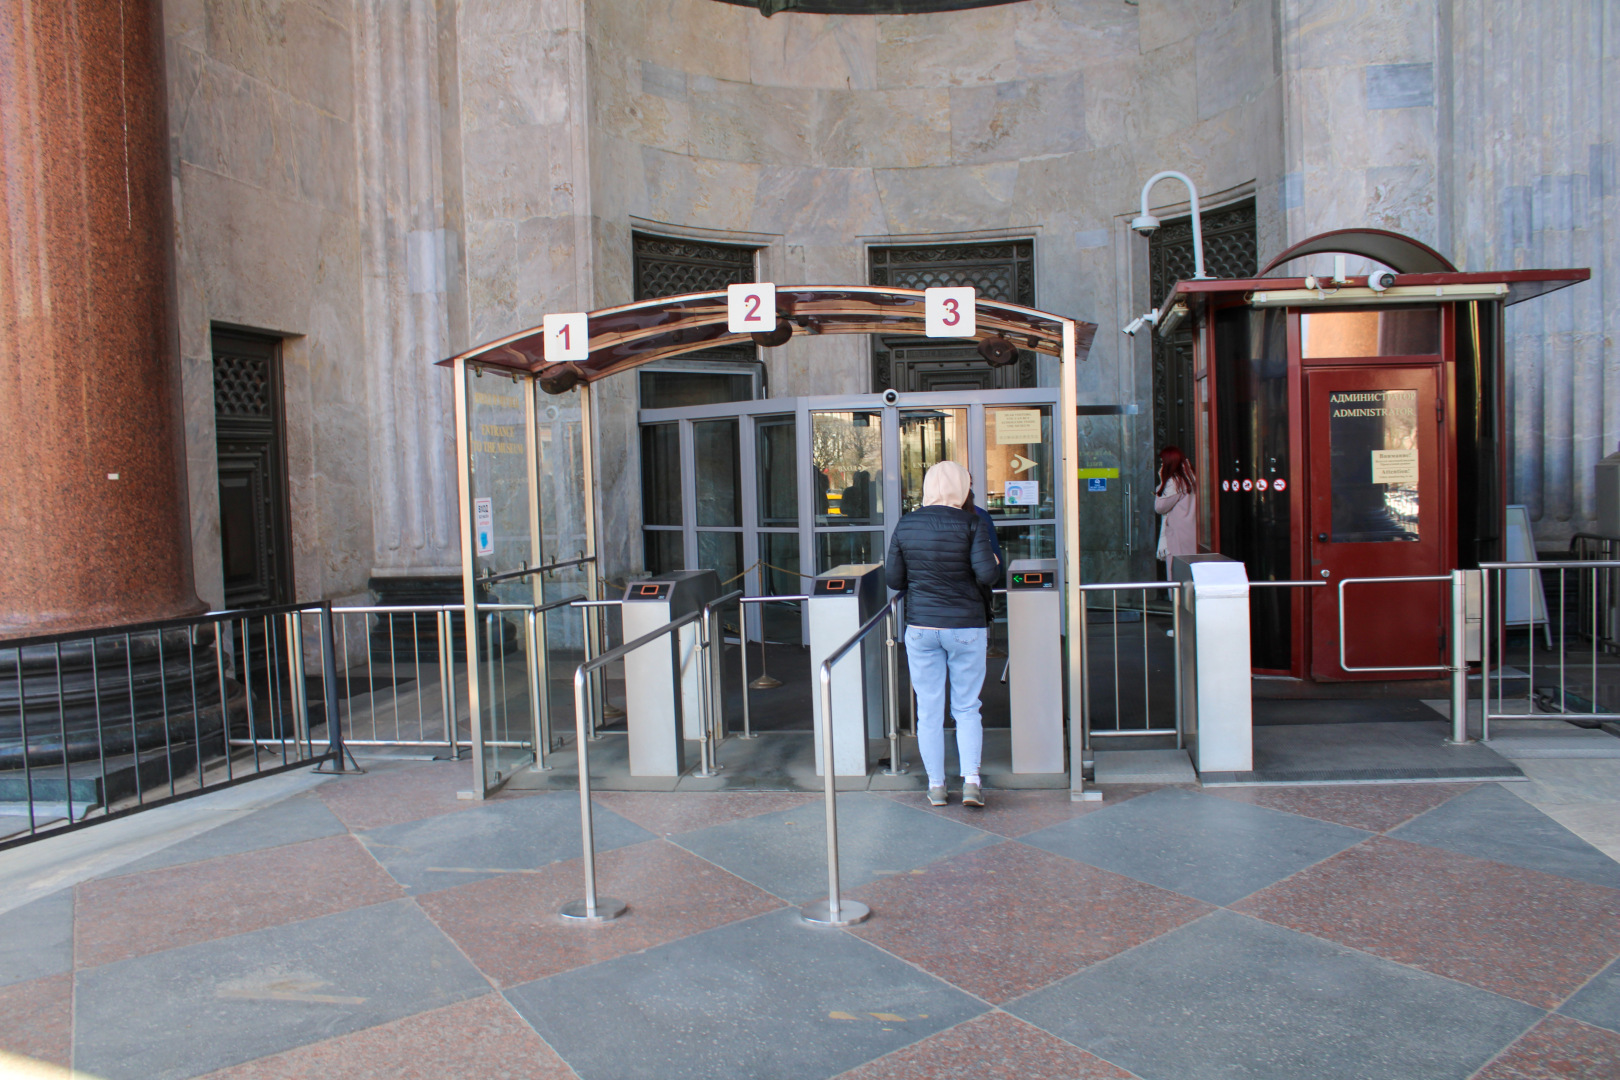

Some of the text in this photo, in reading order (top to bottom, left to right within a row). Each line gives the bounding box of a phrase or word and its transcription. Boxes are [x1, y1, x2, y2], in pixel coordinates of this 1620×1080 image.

[744, 294, 761, 321] 2
[942, 298, 960, 326] 3
[559, 323, 570, 350] 1
[1330, 392, 1416, 403] АДМИНИСТРАТОР
[1333, 408, 1416, 417] ADMINISTRATOR
[481, 424, 514, 438] ENTRANCE
[472, 440, 523, 455] TO THE MUSEUM
